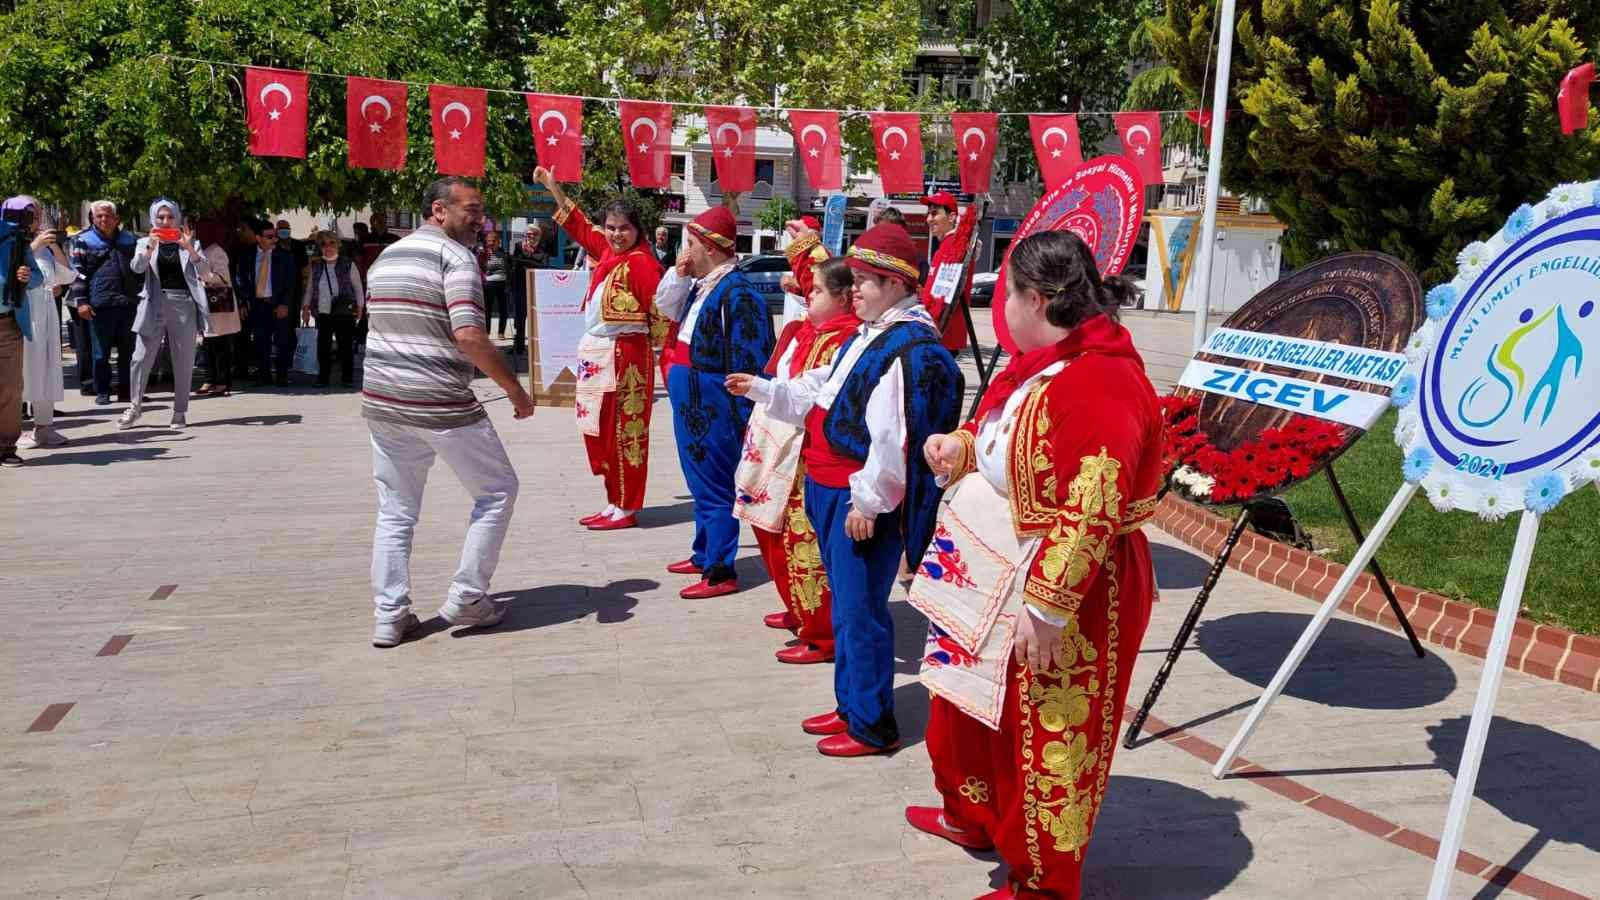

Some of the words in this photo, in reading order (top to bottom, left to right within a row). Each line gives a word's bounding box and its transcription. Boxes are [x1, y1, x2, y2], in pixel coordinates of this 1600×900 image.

[1075, 163, 1107, 181] Sosyal
[1107, 162, 1135, 193] Hizmetler
[1481, 275, 1521, 315] UMUT
[1529, 255, 1600, 280] ENGELLİL
[1208, 331, 1240, 353] 10-16
[1233, 335, 1274, 358] MAYIS
[1266, 341, 1345, 373] ENGELLİLER
[1341, 351, 1407, 381] HAFTASI
[1202, 368, 1350, 413] ZİÇEV
[1455, 452, 1505, 481] 2021
